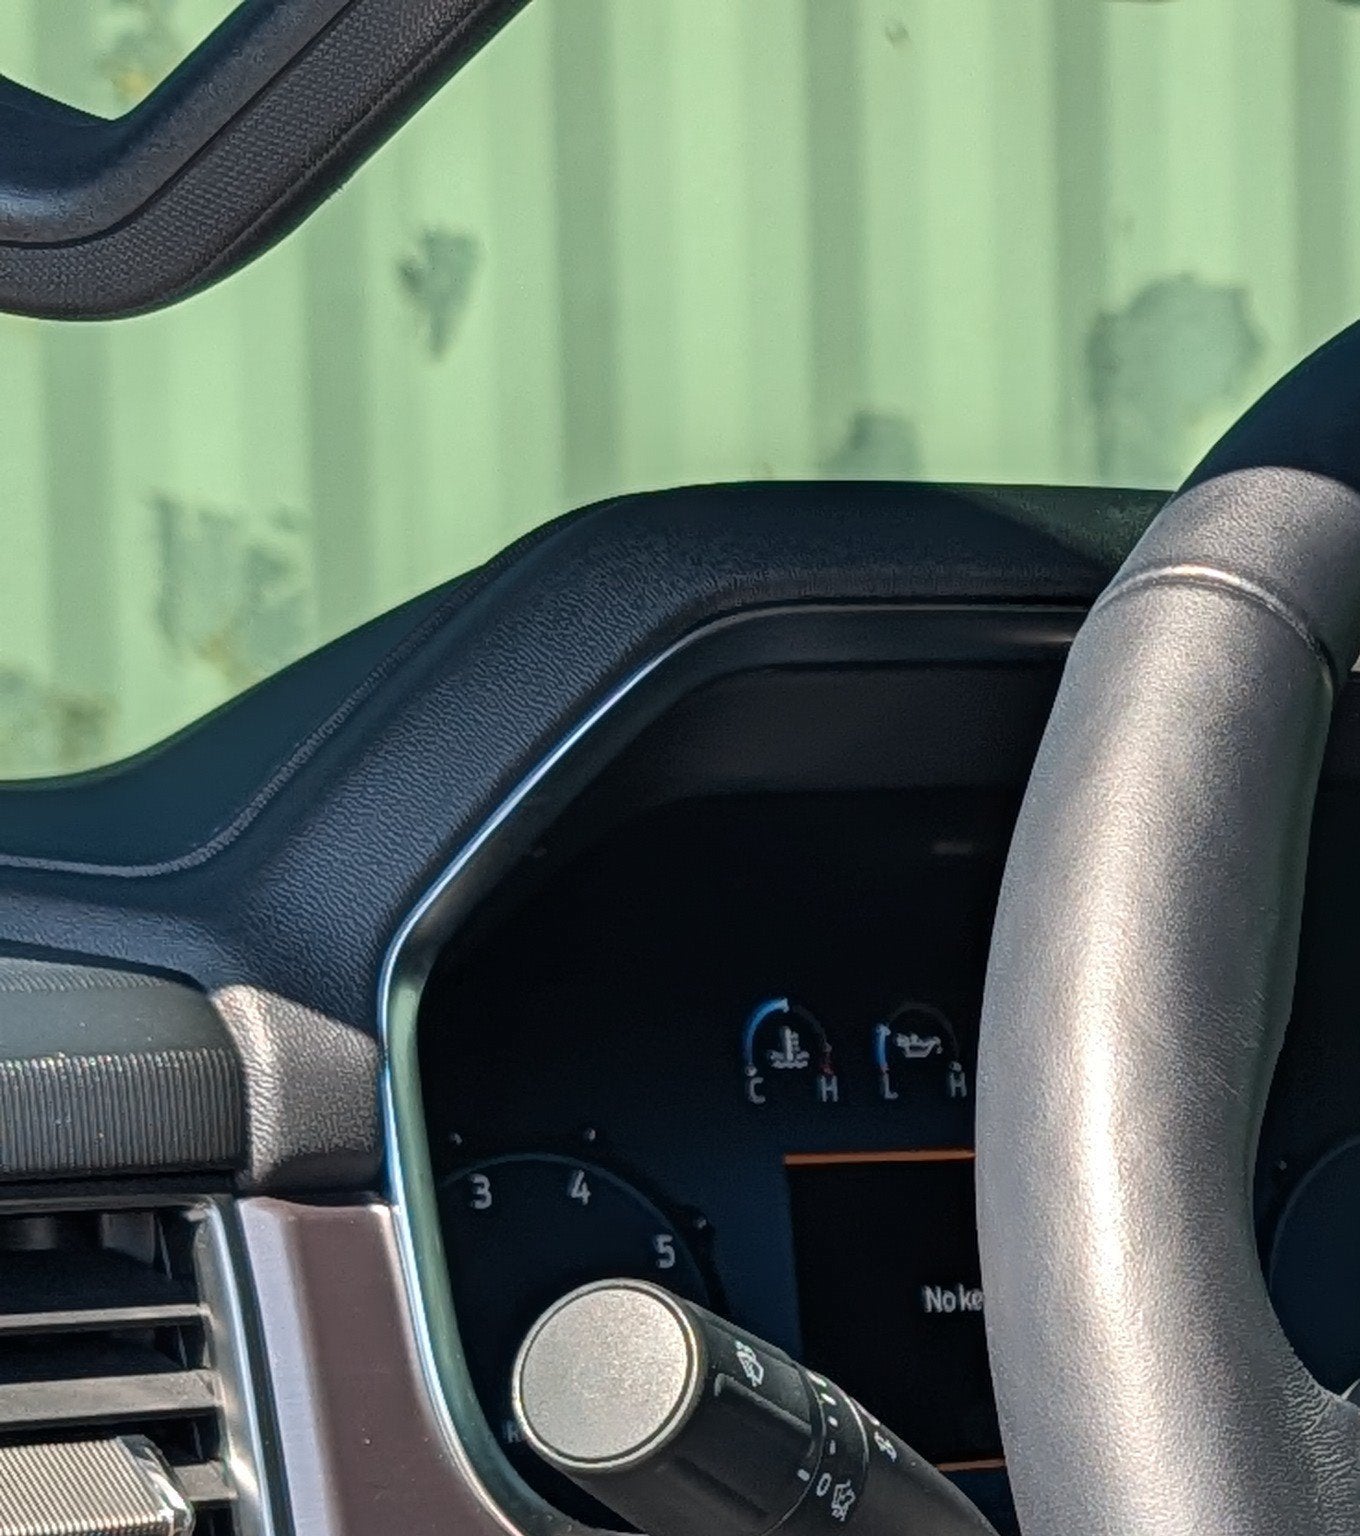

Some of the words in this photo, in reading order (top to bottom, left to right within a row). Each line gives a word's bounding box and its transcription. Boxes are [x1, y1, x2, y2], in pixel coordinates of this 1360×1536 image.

[749, 1077, 766, 1104] C
[820, 1075, 839, 1102] H
[883, 1071, 899, 1100] L
[950, 1071, 968, 1098] H
[471, 1173, 493, 1210] 3
[570, 1169, 592, 1206] 4
[656, 1233, 676, 1270] 5
[923, 1284, 957, 1313] No
